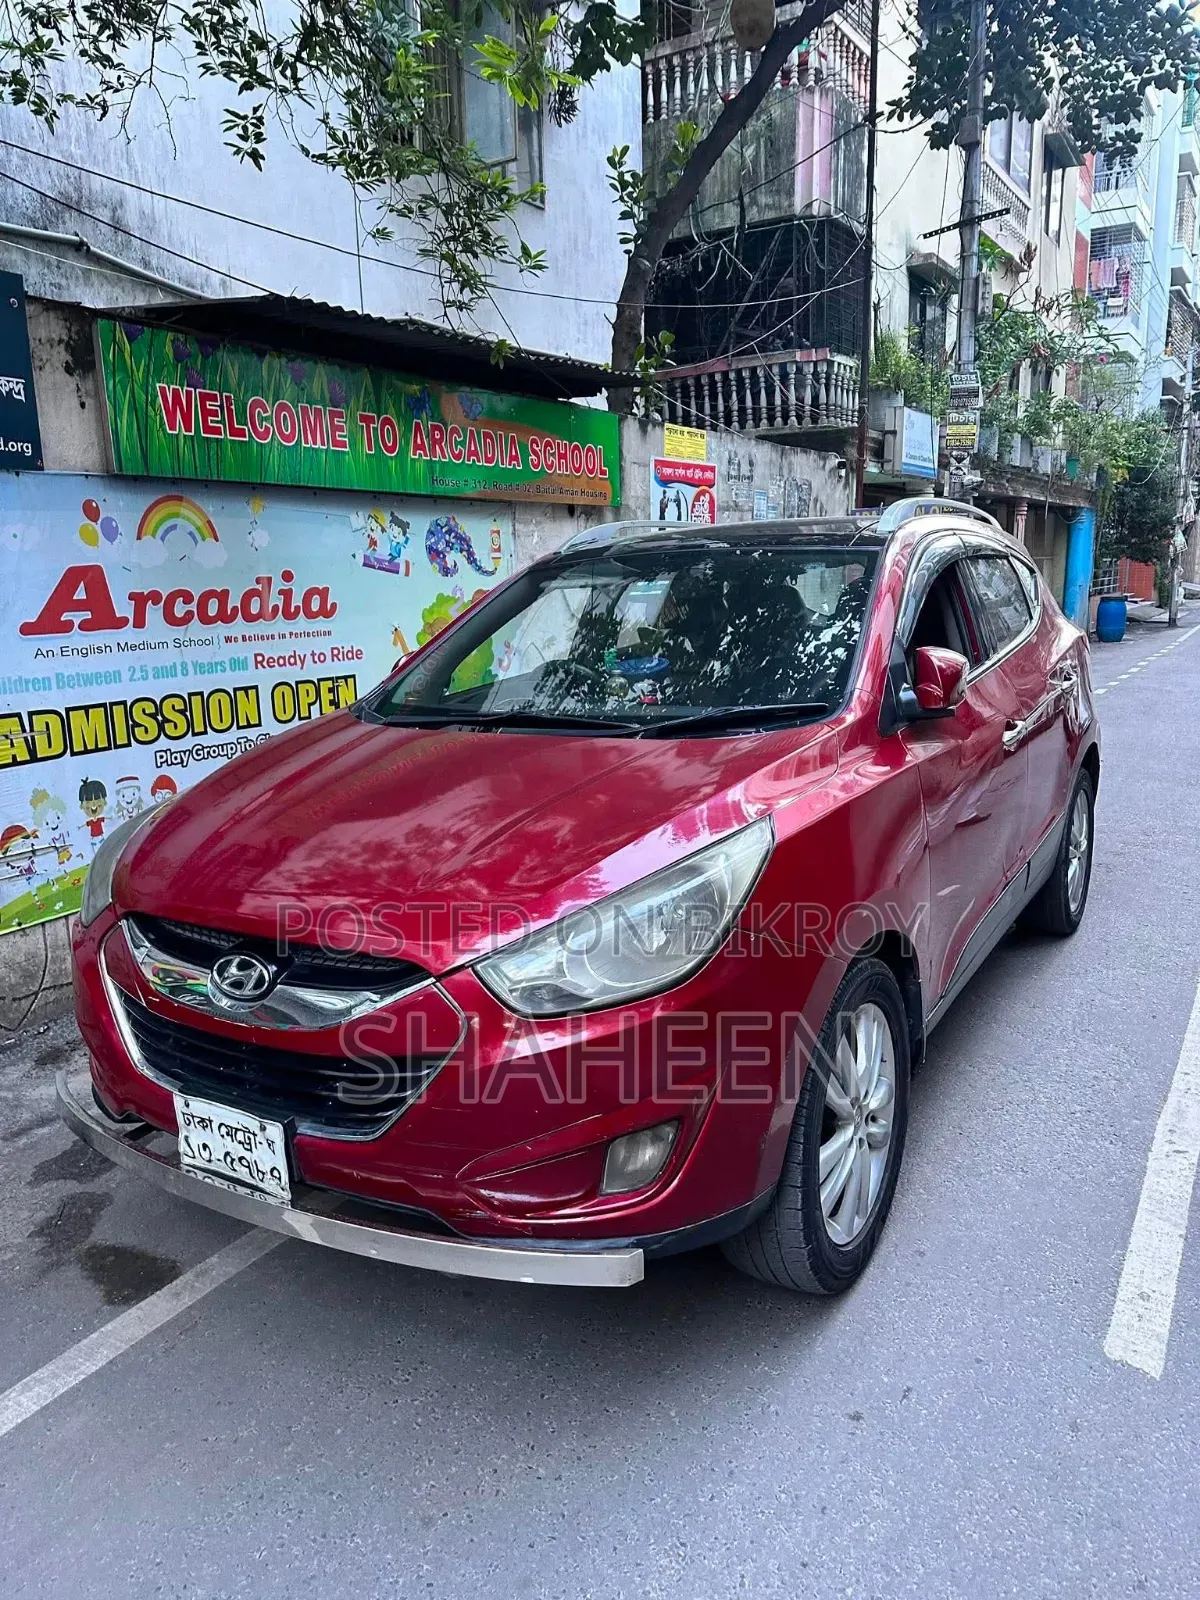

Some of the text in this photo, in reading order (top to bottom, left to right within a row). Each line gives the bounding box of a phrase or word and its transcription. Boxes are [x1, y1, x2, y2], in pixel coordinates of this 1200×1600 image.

[156, 383, 350, 451] WELCOME
[357, 411, 399, 457] TO
[410, 419, 522, 470] ARCADIA
[528, 435, 609, 479] SCHOOL
[431, 475, 461, 488] House
[463, 479, 468, 487] #
[493, 481, 513, 492] Road
[515, 483, 520, 491] #
[559, 486, 579, 497] Aman
[580, 488, 607, 501] Housing
[19, 563, 338, 638] Arcadia
[34, 635, 214, 660] An English Medium School
[224, 629, 332, 644] We Believe in Perfection
[55, 669, 122, 690] Between
[128, 663, 149, 682] 2.5
[152, 661, 178, 680] and
[180, 659, 189, 677] 8
[191, 659, 227, 676] Years
[229, 656, 249, 672] Old
[253, 650, 307, 670] Ready
[311, 649, 327, 664] to
[330, 645, 363, 663] Ride
[0, 674, 358, 768] ADMISSION OPEN
[155, 748, 191, 768] Play
[192, 743, 237, 760] Group
[181, 1110, 213, 1133] ঢাকা
